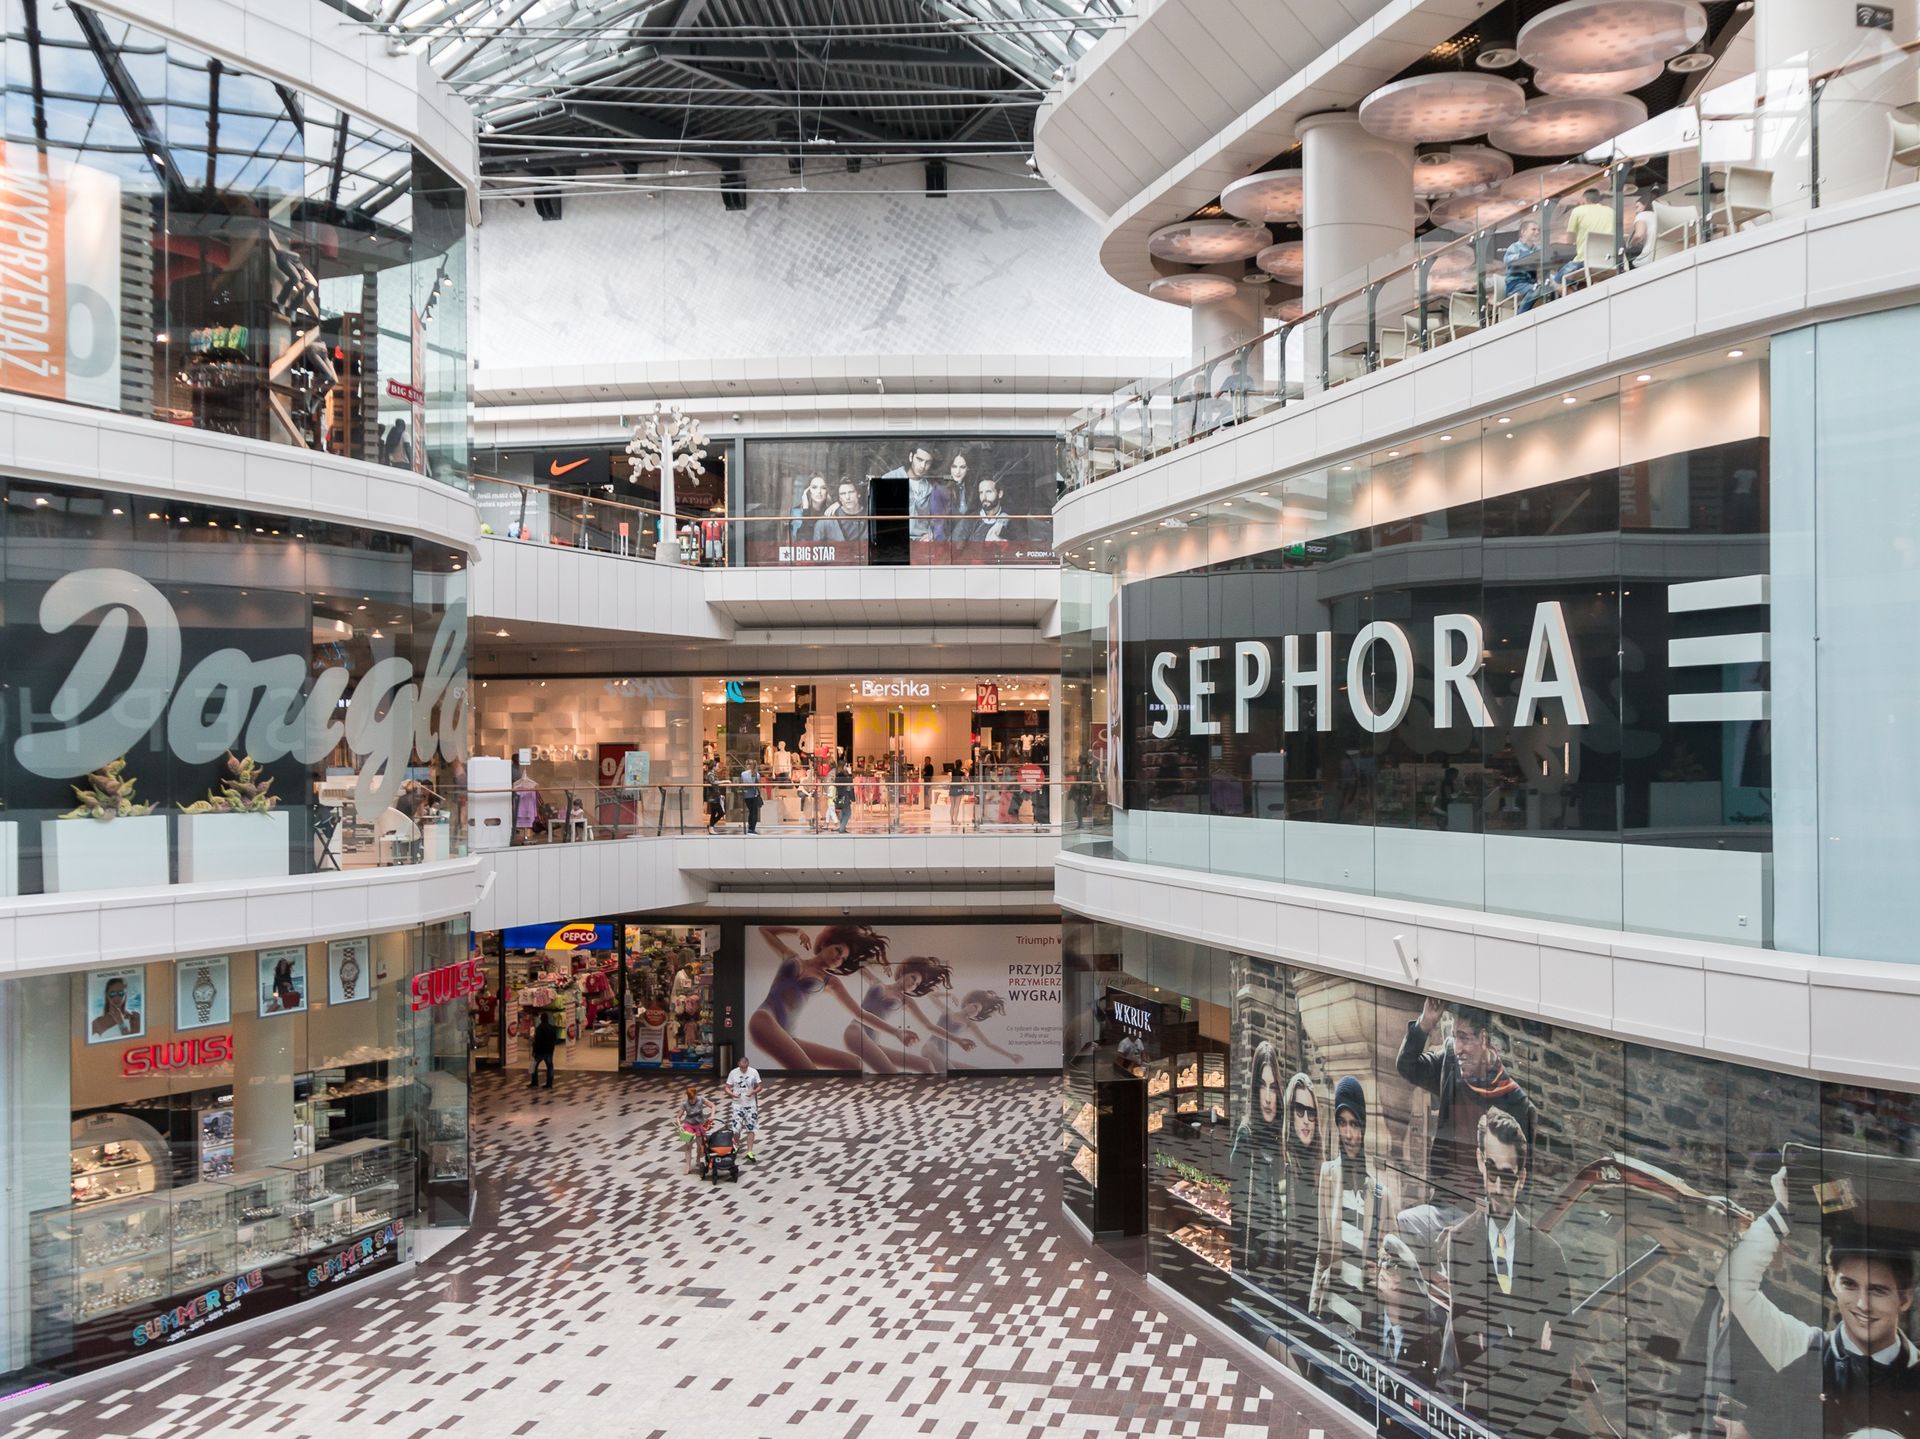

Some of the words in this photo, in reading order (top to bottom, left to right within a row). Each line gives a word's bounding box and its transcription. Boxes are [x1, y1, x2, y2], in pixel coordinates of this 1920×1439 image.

[391, 384, 407, 396] BIG
[796, 546, 811, 561] BIG
[812, 546, 835, 561] STAR
[1151, 601, 1589, 740] SEPHORA
[862, 681, 929, 697] Bershka
[978, 704, 998, 713] SALE
[531, 744, 591, 761] Bershka
[563, 932, 595, 941] PEPCO
[1016, 935, 1055, 947] Triumph
[1008, 962, 1062, 977] PRZYJDŹ
[411, 955, 485, 1012] SWISS
[1008, 977, 1062, 987] PRZYMIERZ
[1008, 990, 1062, 1004] WYGRAJ
[307, 1236, 374, 1288] SUMMER
[374, 1217, 405, 1249] SALE
[132, 1289, 222, 1346] SUMMER
[222, 1267, 264, 1302] SALE
[1336, 1344, 1400, 1401] TOMMY
